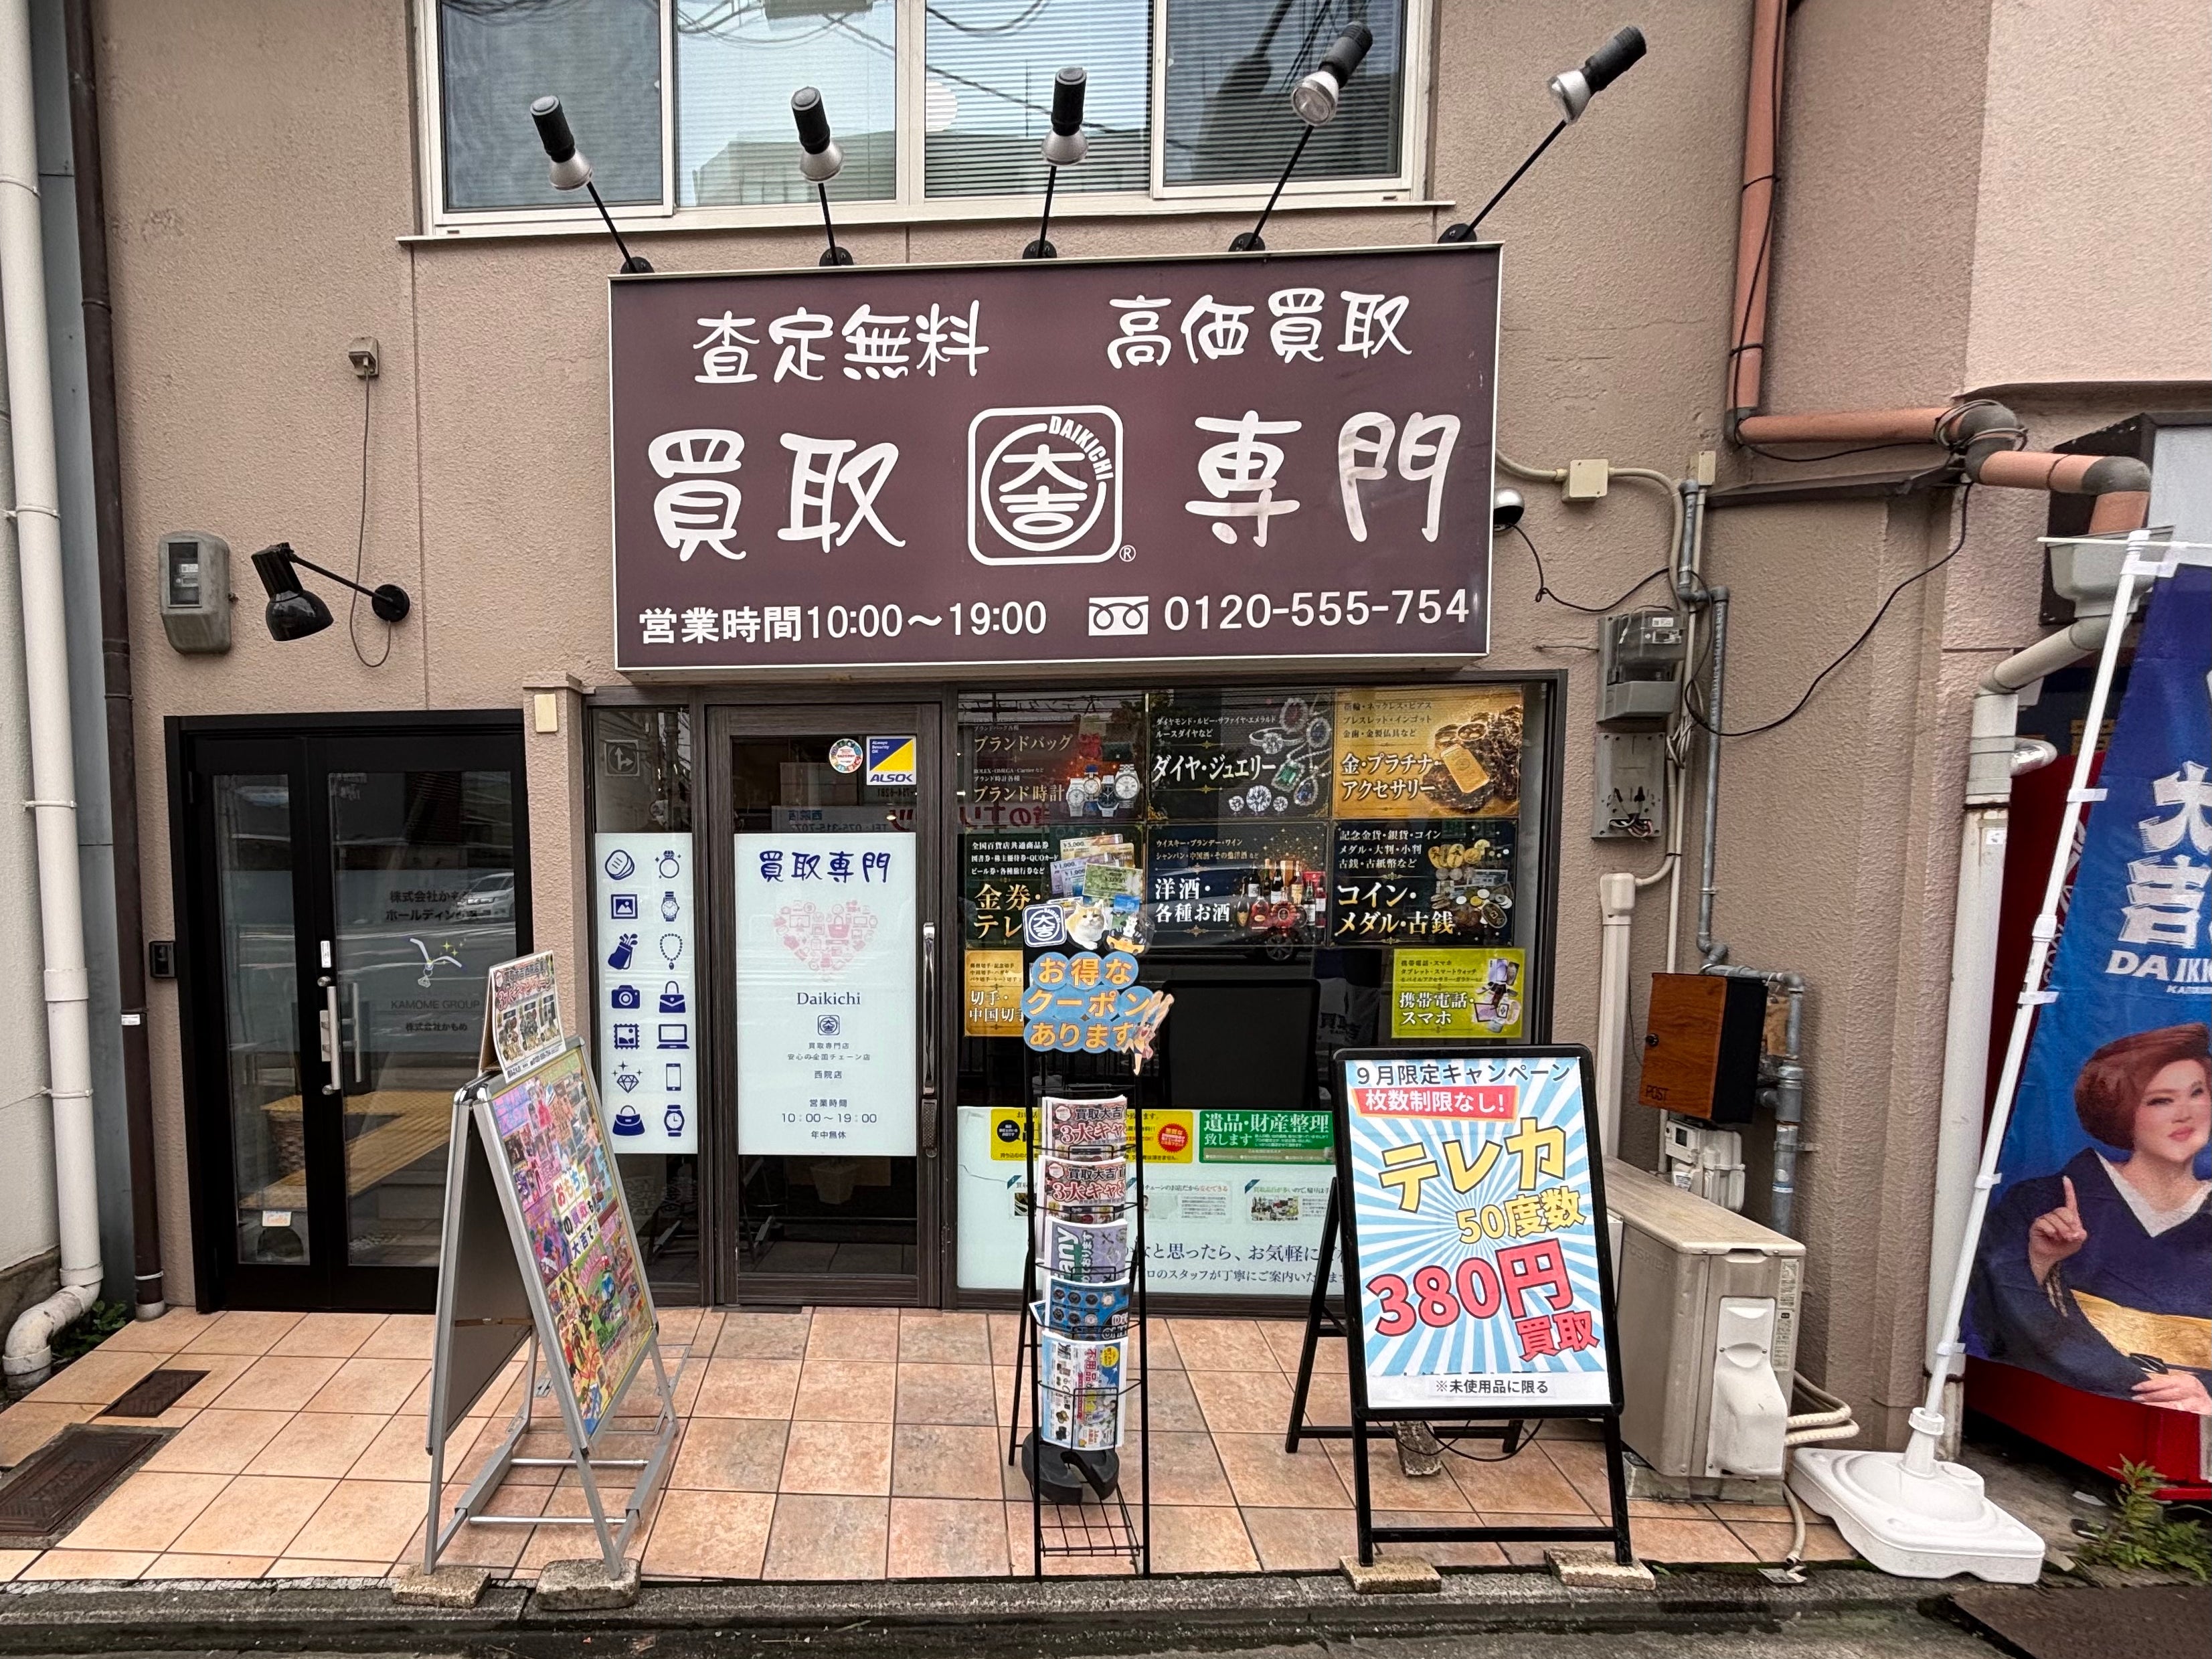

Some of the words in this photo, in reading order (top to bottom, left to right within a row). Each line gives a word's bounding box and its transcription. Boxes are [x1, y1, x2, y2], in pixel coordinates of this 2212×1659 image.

[1106, 287, 1413, 371] 高価買取
[693, 299, 989, 385] 査定無料
[1048, 415, 1114, 481] DAIKICHI
[1184, 410, 1462, 549] 専門
[647, 428, 906, 563] 買取
[1163, 588, 1470, 632] 0120-555-754
[974, 733, 1074, 754] ブランドバッグ
[870, 774, 914, 783] ALSOK
[1152, 754, 1276, 783] ダイヤ・ジュエリー
[974, 784, 1066, 804] ブランド時計
[1342, 780, 1436, 802] アクセサリー
[1339, 829, 1442, 841] 記念金貨・銀貨・コイン
[758, 851, 891, 884] 買取専門
[1155, 903, 1231, 924] 各種お酒
[1335, 910, 1454, 936] メダル・古銭
[1038, 956, 1132, 986] お得な
[391, 1000, 439, 1009] KAMOME
[442, 1000, 481, 1009] GROUP
[796, 991, 861, 1005] Daikichi
[1026, 989, 1151, 1018] クーポン
[1401, 1011, 1452, 1026] スマホ
[787, 1053, 871, 1061] 安心の全国チェーン店
[808, 1042, 850, 1050] 買取専門店
[814, 1070, 842, 1079] 西院店
[1357, 1063, 1571, 1085] 9月限定キャンペーン
[809, 1098, 848, 1108] 営業時間
[1645, 1084, 1670, 1102] POST
[1075, 1106, 1123, 1121] 買取大吉
[1203, 1112, 1329, 1134] 遺品・財産整理
[811, 1130, 847, 1140] 年中無休
[1060, 1122, 1126, 1144] 3大キャ
[1204, 1133, 1253, 1146] 致します
[1379, 1116, 1567, 1214] テレカ
[1456, 1186, 1587, 1245] 50度数
[1365, 1237, 1574, 1337] 380円
[1515, 1310, 1601, 1363] 買取
